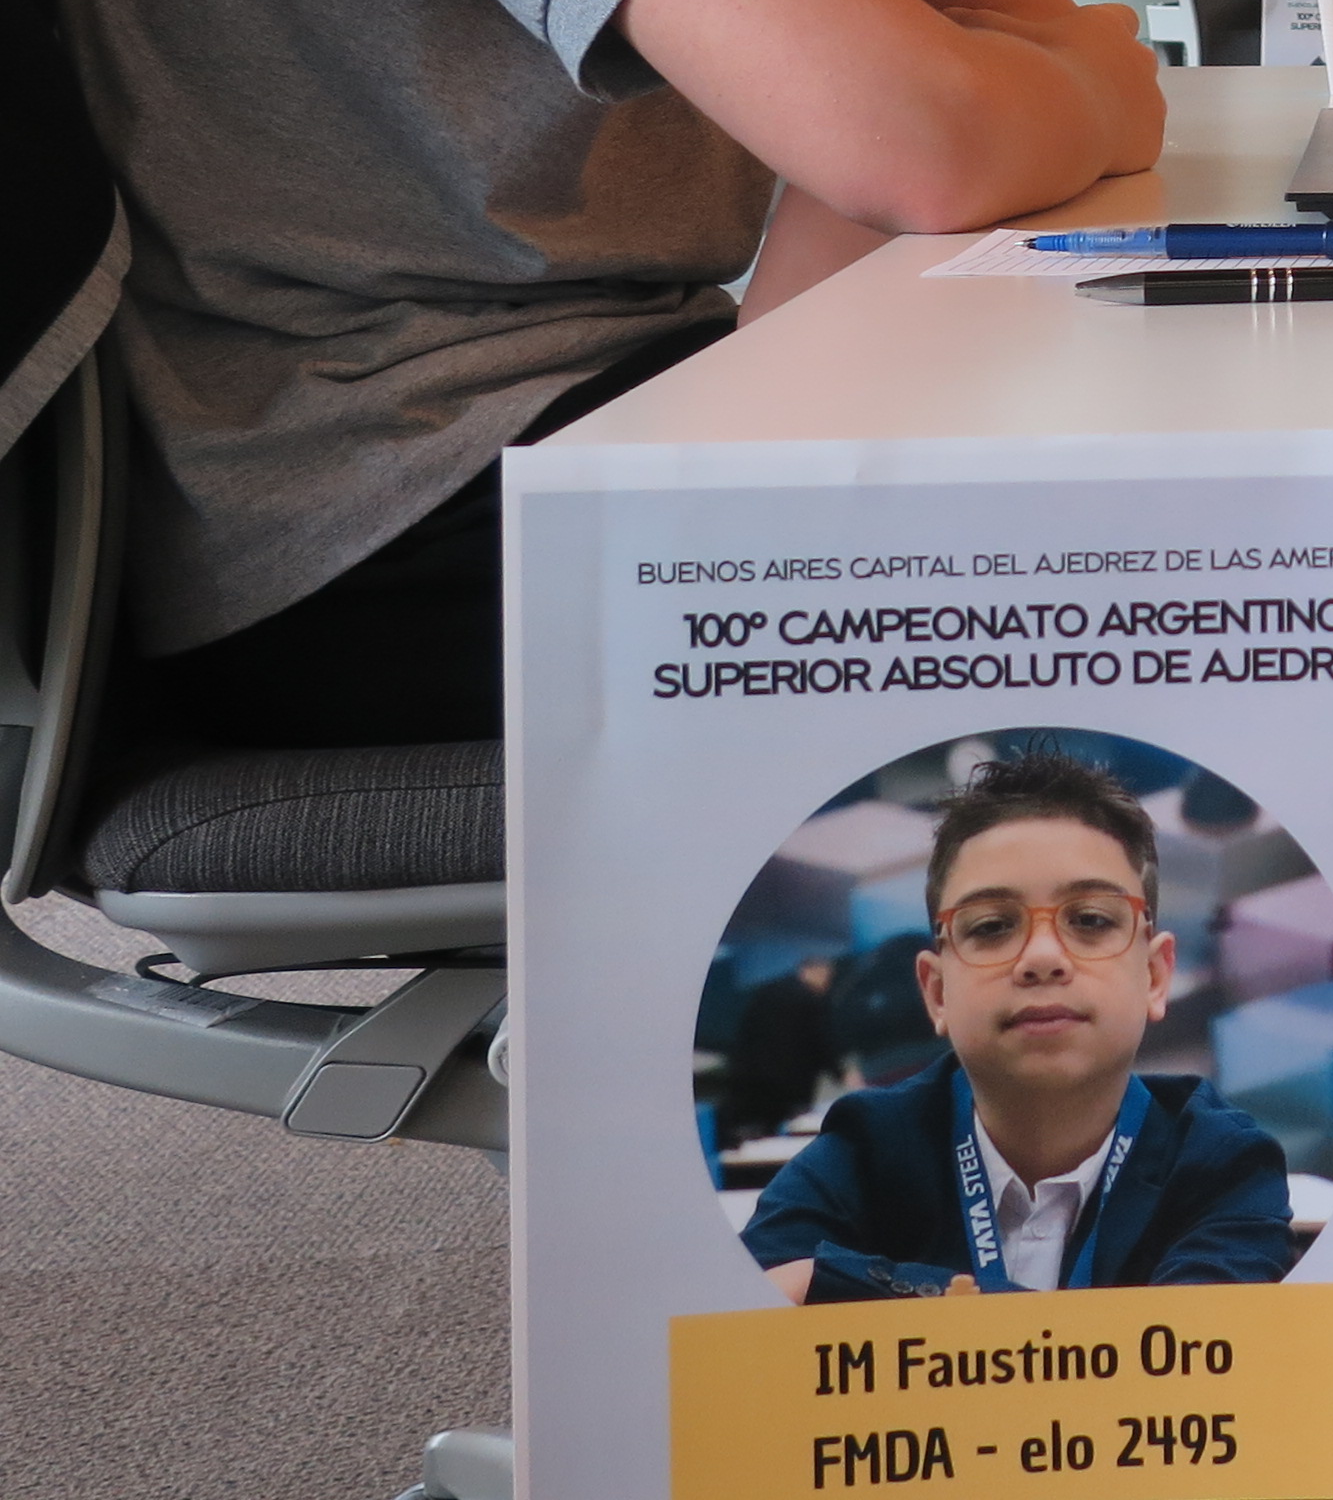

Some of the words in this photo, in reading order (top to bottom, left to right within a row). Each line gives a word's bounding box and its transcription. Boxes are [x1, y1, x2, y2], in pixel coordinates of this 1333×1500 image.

[637, 559, 756, 585] BUENOS
[762, 557, 843, 582] AIRES
[849, 555, 966, 580] CAPITAL
[972, 553, 1028, 577] DEL
[1033, 550, 1158, 575] AJEDREZ
[1165, 549, 1203, 572] DE
[1210, 547, 1263, 571] LAS
[778, 603, 1089, 646] CAMPEONATO
[653, 657, 873, 699] SUPERIOR
[879, 650, 1122, 692] ABSOLUTO
[1132, 649, 1192, 685] DE
[957, 1134, 984, 1198] STEEL
[969, 1199, 998, 1268] TATA
[814, 1339, 875, 1397] IM
[897, 1329, 1119, 1391] Faustino
[1140, 1324, 1233, 1377] Oro
[813, 1426, 955, 1490] FMDA
[1020, 1419, 1095, 1474] elo
[1116, 1413, 1237, 1468] 2495
